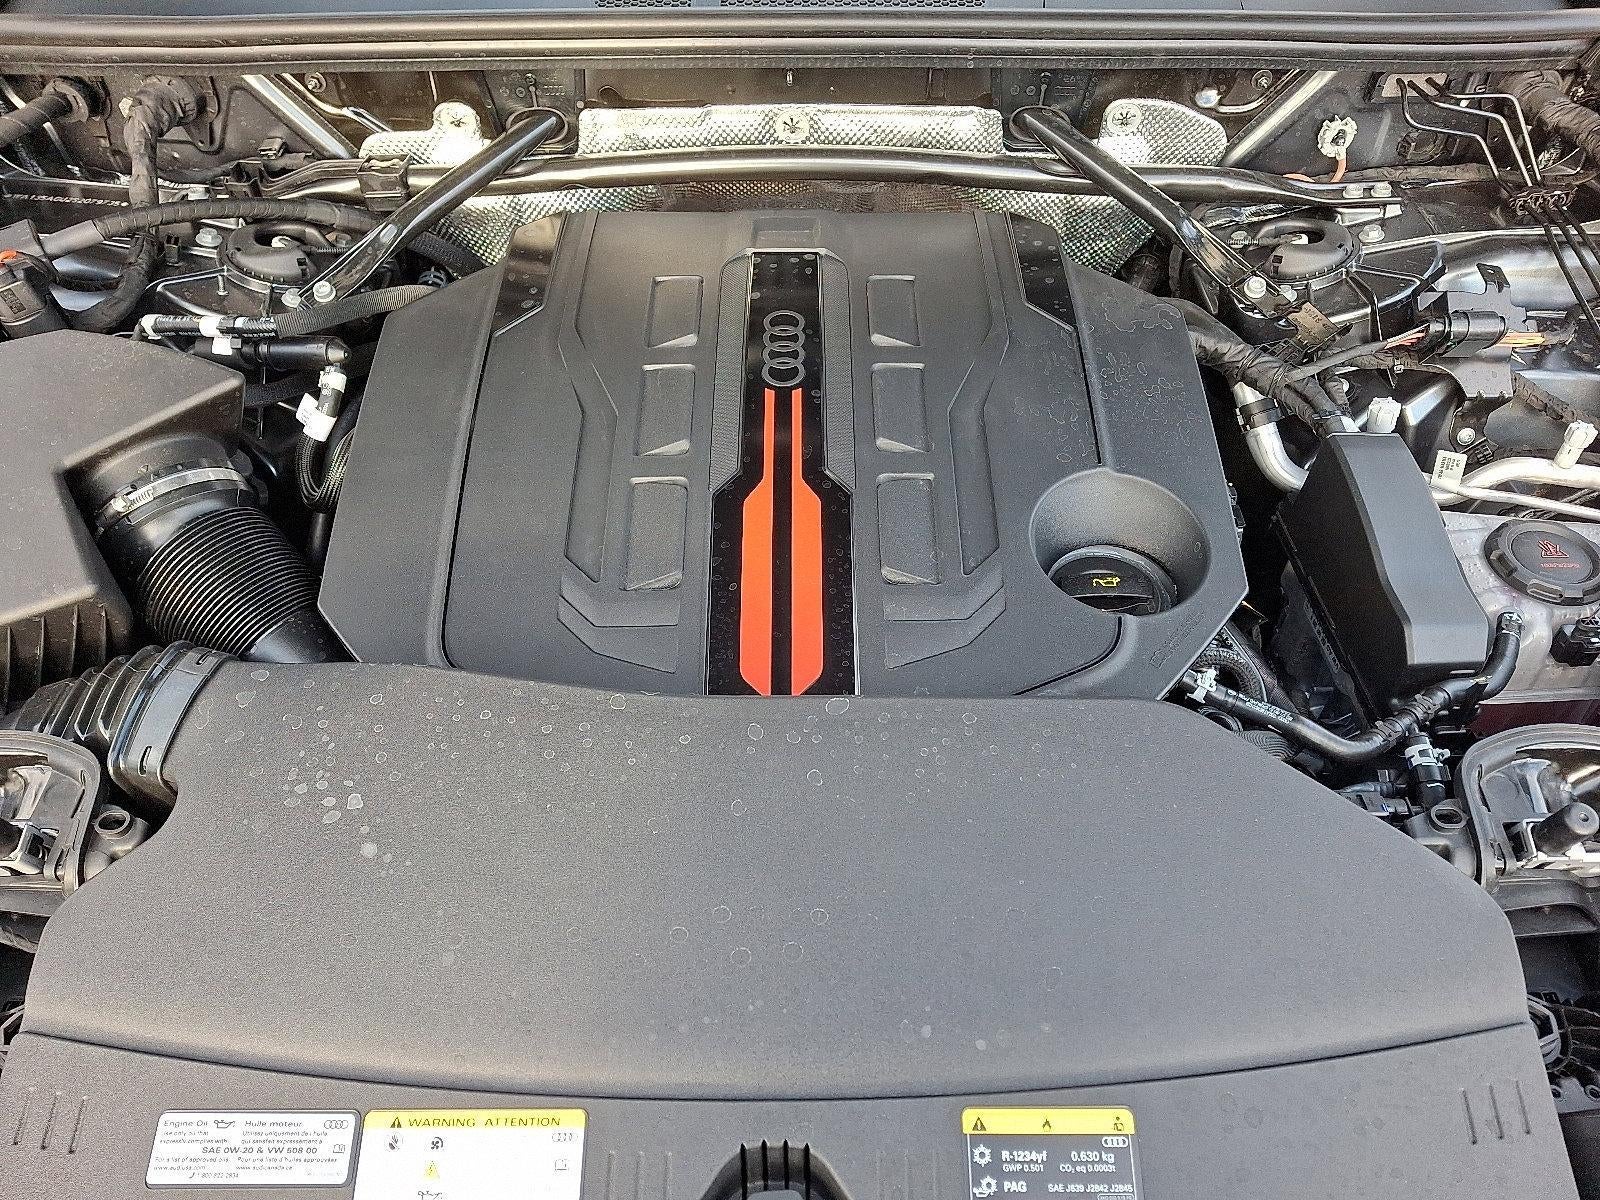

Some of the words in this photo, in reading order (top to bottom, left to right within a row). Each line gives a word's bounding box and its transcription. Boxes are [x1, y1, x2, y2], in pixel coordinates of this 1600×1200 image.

[163, 1119, 194, 1128] Engine
[196, 1119, 208, 1127] Oil
[244, 1120, 267, 1128] Huile
[269, 1120, 302, 1128] moteur
[408, 1118, 476, 1127] WARNING
[484, 1117, 561, 1127] ATTENTION
[201, 1146, 222, 1154] SAE
[223, 1146, 254, 1154] 0W-20
[1001, 1150, 1048, 1164] R-1234yf
[1070, 1150, 1100, 1162] 0.630
[1101, 1150, 1115, 1164] kg
[1002, 1163, 1023, 1172] GWP
[1023, 1163, 1044, 1172] 0.501
[1075, 1165, 1087, 1174] eq
[1003, 1180, 1028, 1193] PAG
[1047, 1183, 1065, 1193] SAE
[1085, 1183, 1109, 1193] J2842
[1109, 1183, 1134, 1193] J2845
